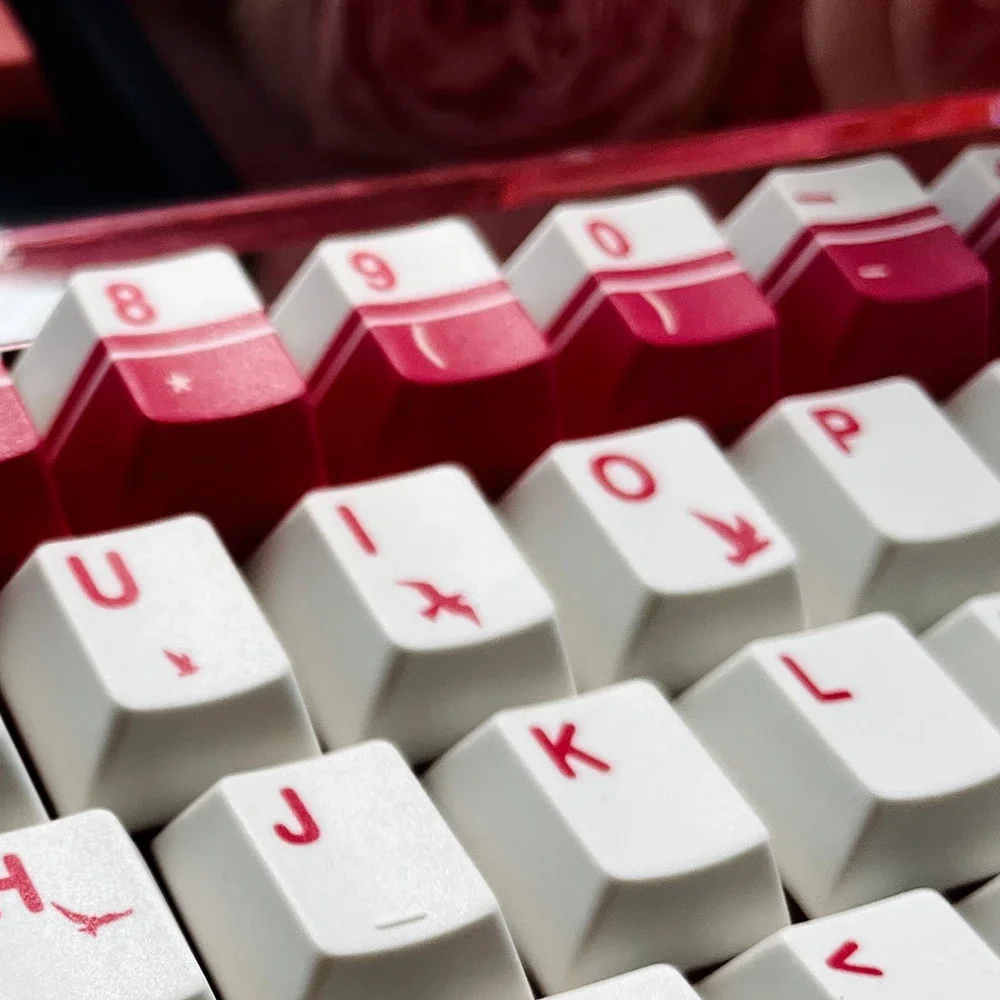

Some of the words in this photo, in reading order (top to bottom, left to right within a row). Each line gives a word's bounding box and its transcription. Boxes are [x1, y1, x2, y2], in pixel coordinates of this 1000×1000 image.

[350, 250, 398, 291] 9
[104, 282, 158, 327] 8
[639, 290, 677, 335] )
[410, 320, 449, 370] (
[811, 406, 867, 455] P
[337, 503, 379, 555] I
[66, 551, 140, 609] U
[780, 654, 854, 704] L
[530, 722, 611, 780] K
[273, 786, 321, 846] J
[825, 940, 885, 978] <
